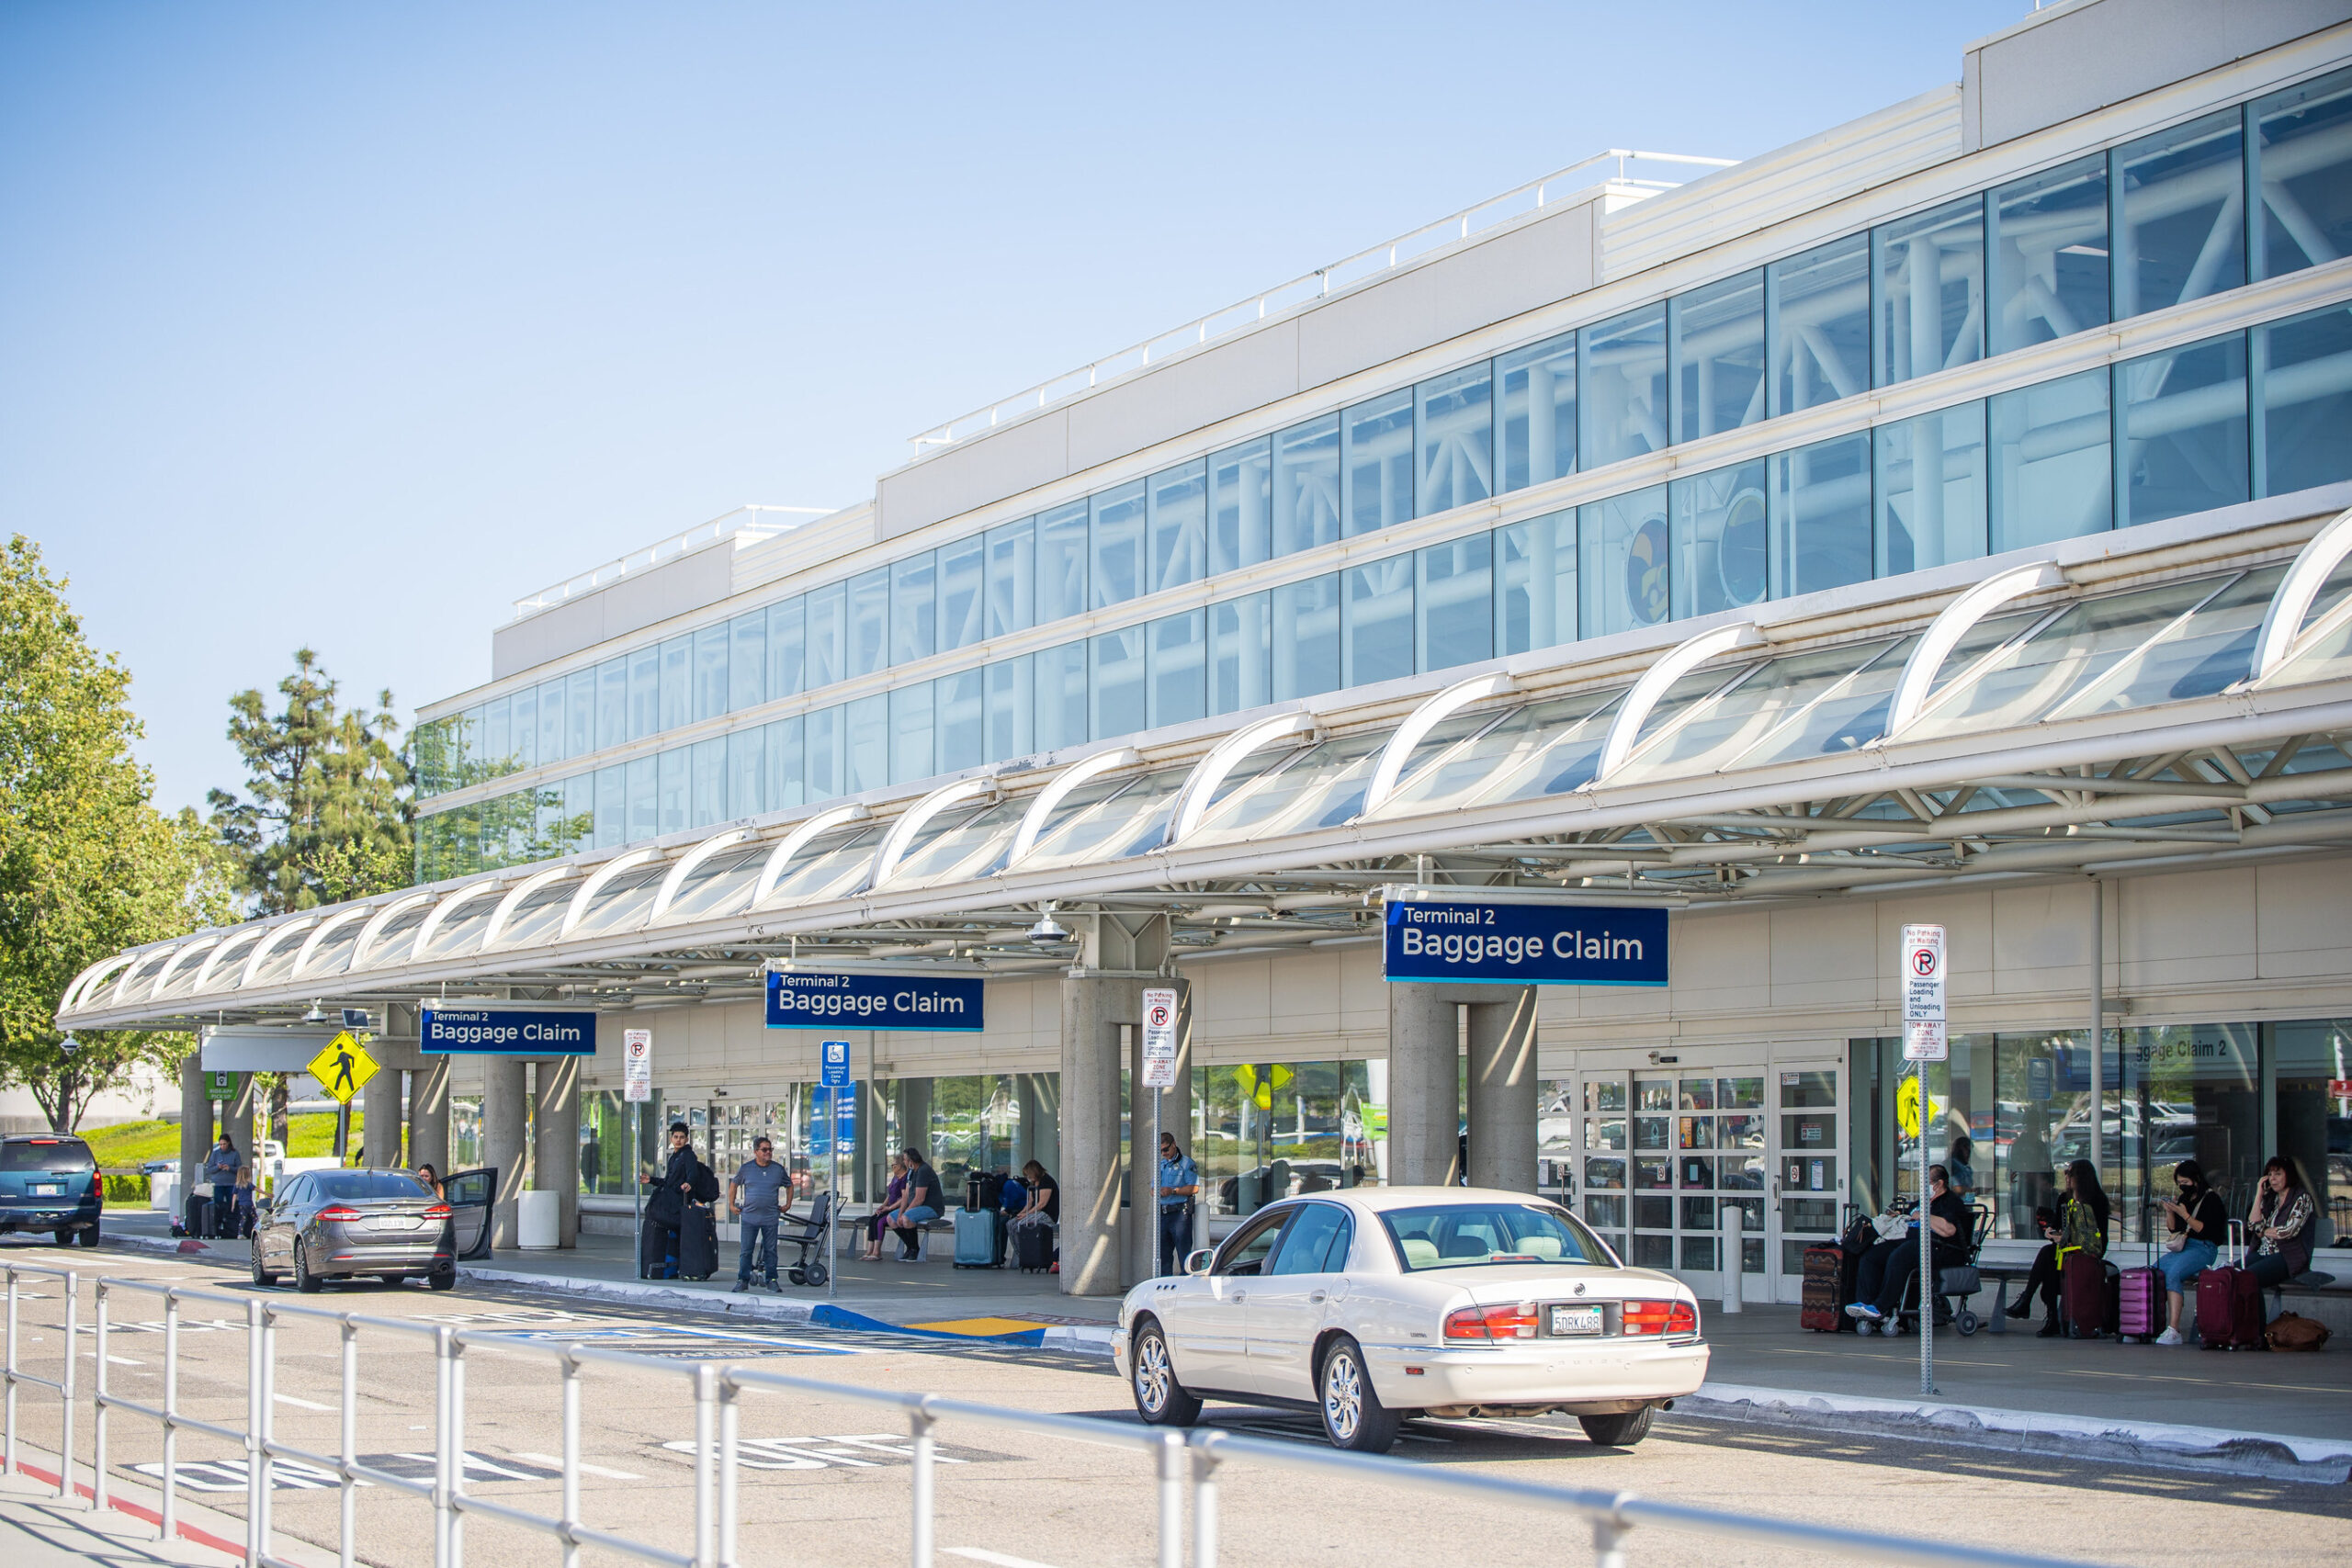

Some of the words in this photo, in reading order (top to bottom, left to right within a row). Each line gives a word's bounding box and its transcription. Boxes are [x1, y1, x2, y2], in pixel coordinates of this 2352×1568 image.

[1403, 907, 1480, 924] Terminal
[1485, 909, 1496, 925] 2
[1917, 930, 1940, 938] Parking
[1402, 928, 1544, 964] Baggage
[1552, 930, 1643, 960] Claim
[780, 975, 838, 987] Terminal
[842, 976, 850, 988] 2
[779, 989, 888, 1017] Baggage
[893, 991, 964, 1013] Claim
[1910, 1003, 1940, 1012] Unloading
[434, 1011, 481, 1021] Terminal
[482, 1013, 489, 1021] 2
[431, 1022, 518, 1043] Baggage
[523, 1023, 581, 1041] Claim
[2177, 1039, 2214, 1057] Claim
[2218, 1039, 2228, 1056] 2
[1555, 1315, 1600, 1330] 5DRK488
